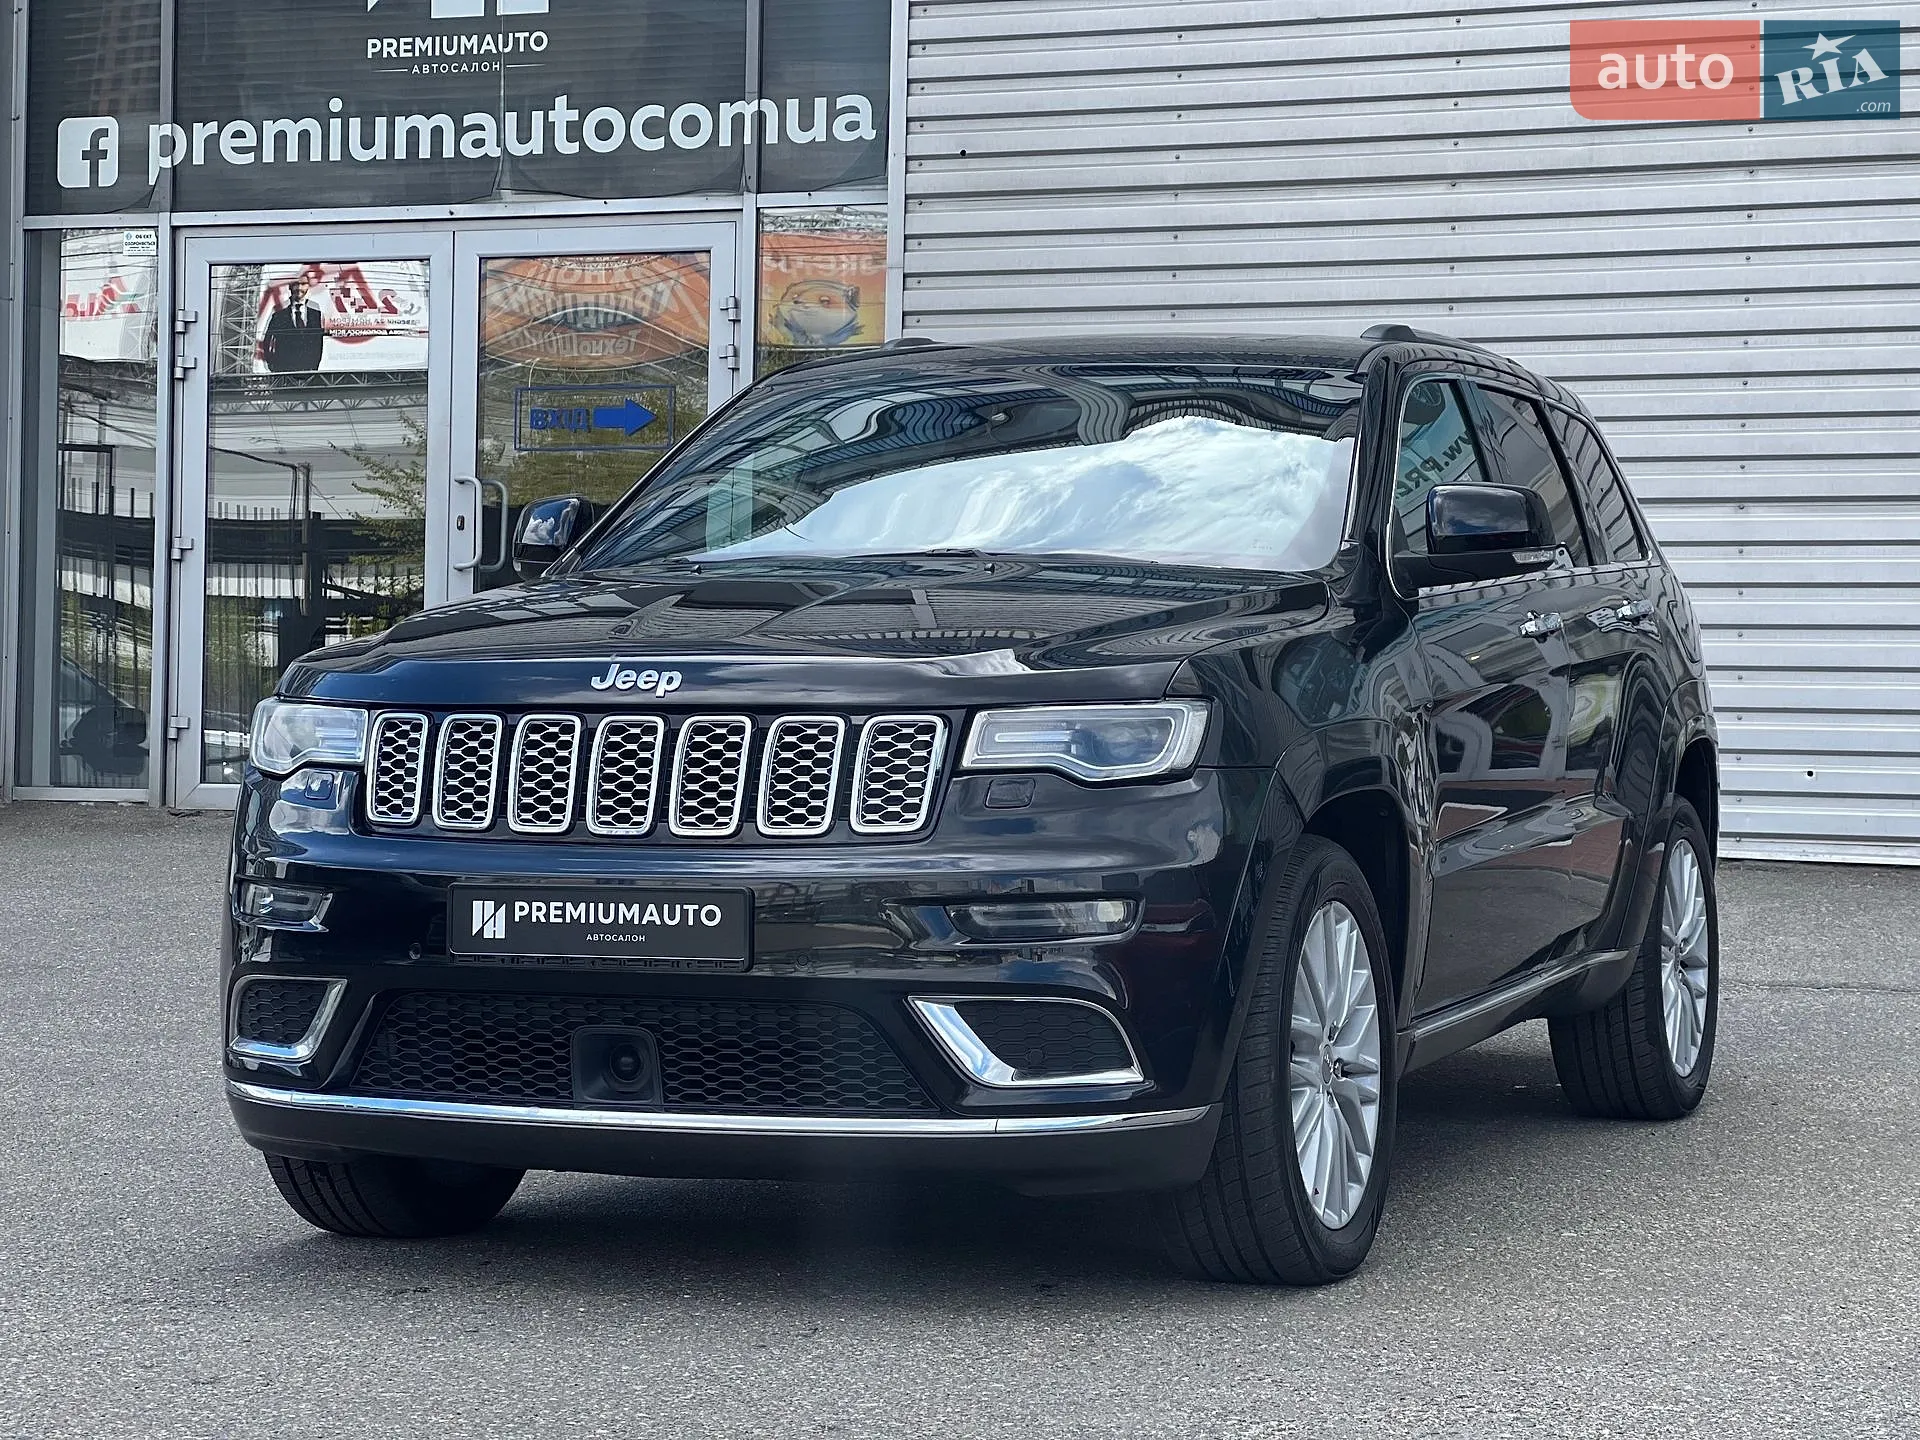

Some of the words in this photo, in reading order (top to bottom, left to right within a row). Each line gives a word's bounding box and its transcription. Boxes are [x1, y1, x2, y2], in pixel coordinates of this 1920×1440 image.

[367, 30, 549, 59] PREMIUMAUTO
[411, 61, 500, 74] АВТОСАЛОН
[147, 93, 877, 185] premiumautocomua
[529, 407, 592, 433] ВХІД
[590, 663, 683, 697] Jeep
[513, 900, 722, 927] PREMIUMAUTO
[585, 932, 646, 942] АВТОСАЛОН
